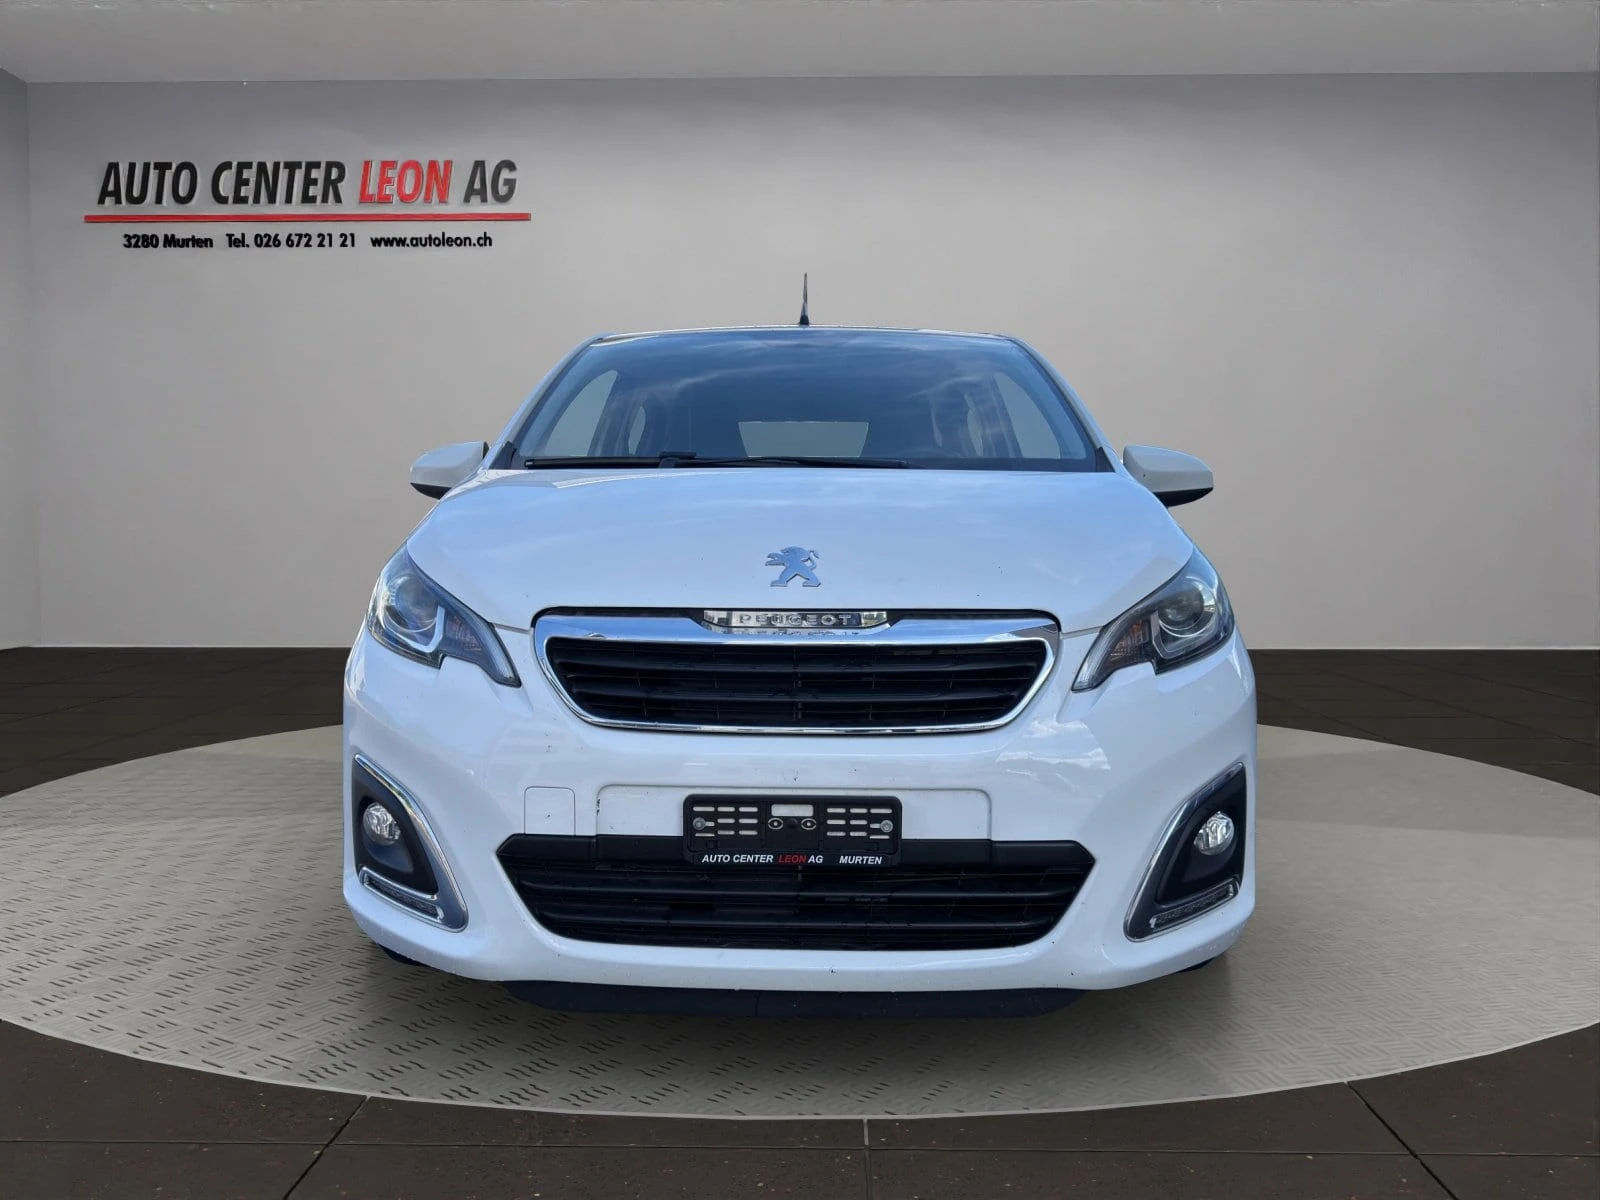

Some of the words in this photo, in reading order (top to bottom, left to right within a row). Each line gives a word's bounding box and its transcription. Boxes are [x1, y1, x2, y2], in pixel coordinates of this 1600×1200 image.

[97, 160, 199, 205] AUTO
[210, 159, 348, 205] CENTER
[358, 159, 454, 205] LEON
[462, 159, 519, 204] AG
[123, 233, 159, 250] 3280
[162, 233, 214, 249] Murten
[225, 233, 250, 249] Tel.
[253, 233, 282, 249] 026
[285, 233, 314, 249] 672
[316, 233, 335, 249] 21
[338, 233, 357, 249] 21
[370, 232, 493, 249] www.autoleon.ch
[739, 614, 852, 626] PEUGEOT
[701, 854, 731, 863] AUTO
[732, 854, 774, 864] CENTER
[778, 854, 807, 864] LEON
[807, 855, 824, 864] AG
[839, 855, 883, 865] MURTEN
